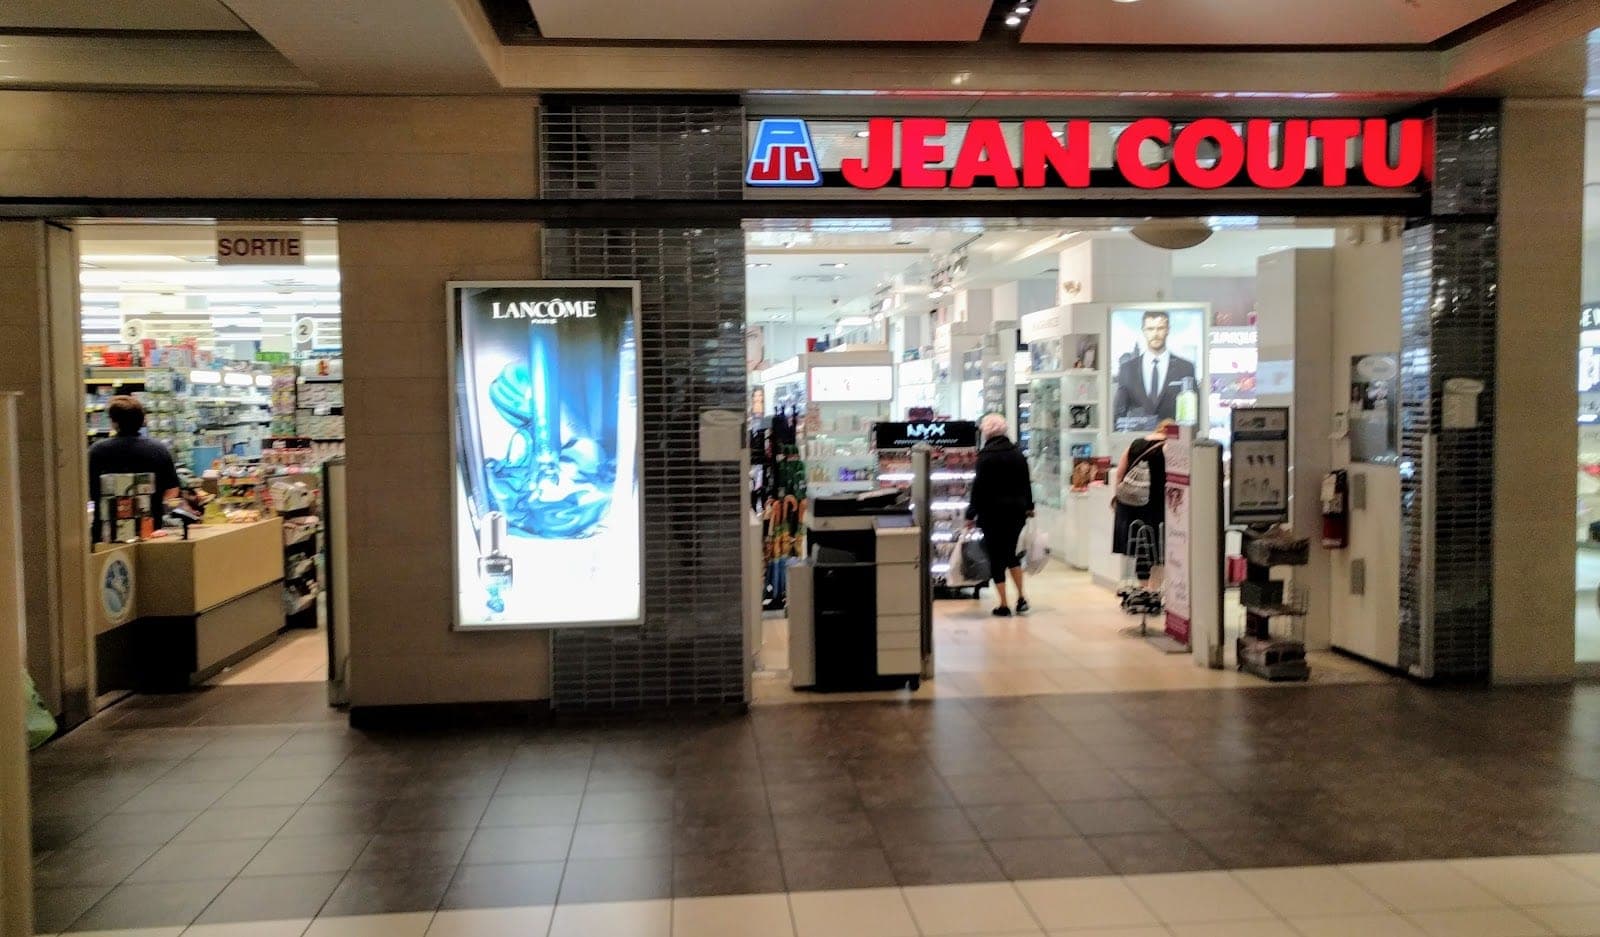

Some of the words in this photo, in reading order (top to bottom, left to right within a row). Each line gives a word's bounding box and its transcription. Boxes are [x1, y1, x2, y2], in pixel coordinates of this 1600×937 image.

[841, 118, 1091, 189] JEAN
[217, 237, 301, 257] SORTIE
[492, 298, 597, 319] LANCÔME
[906, 423, 946, 440] NYX
